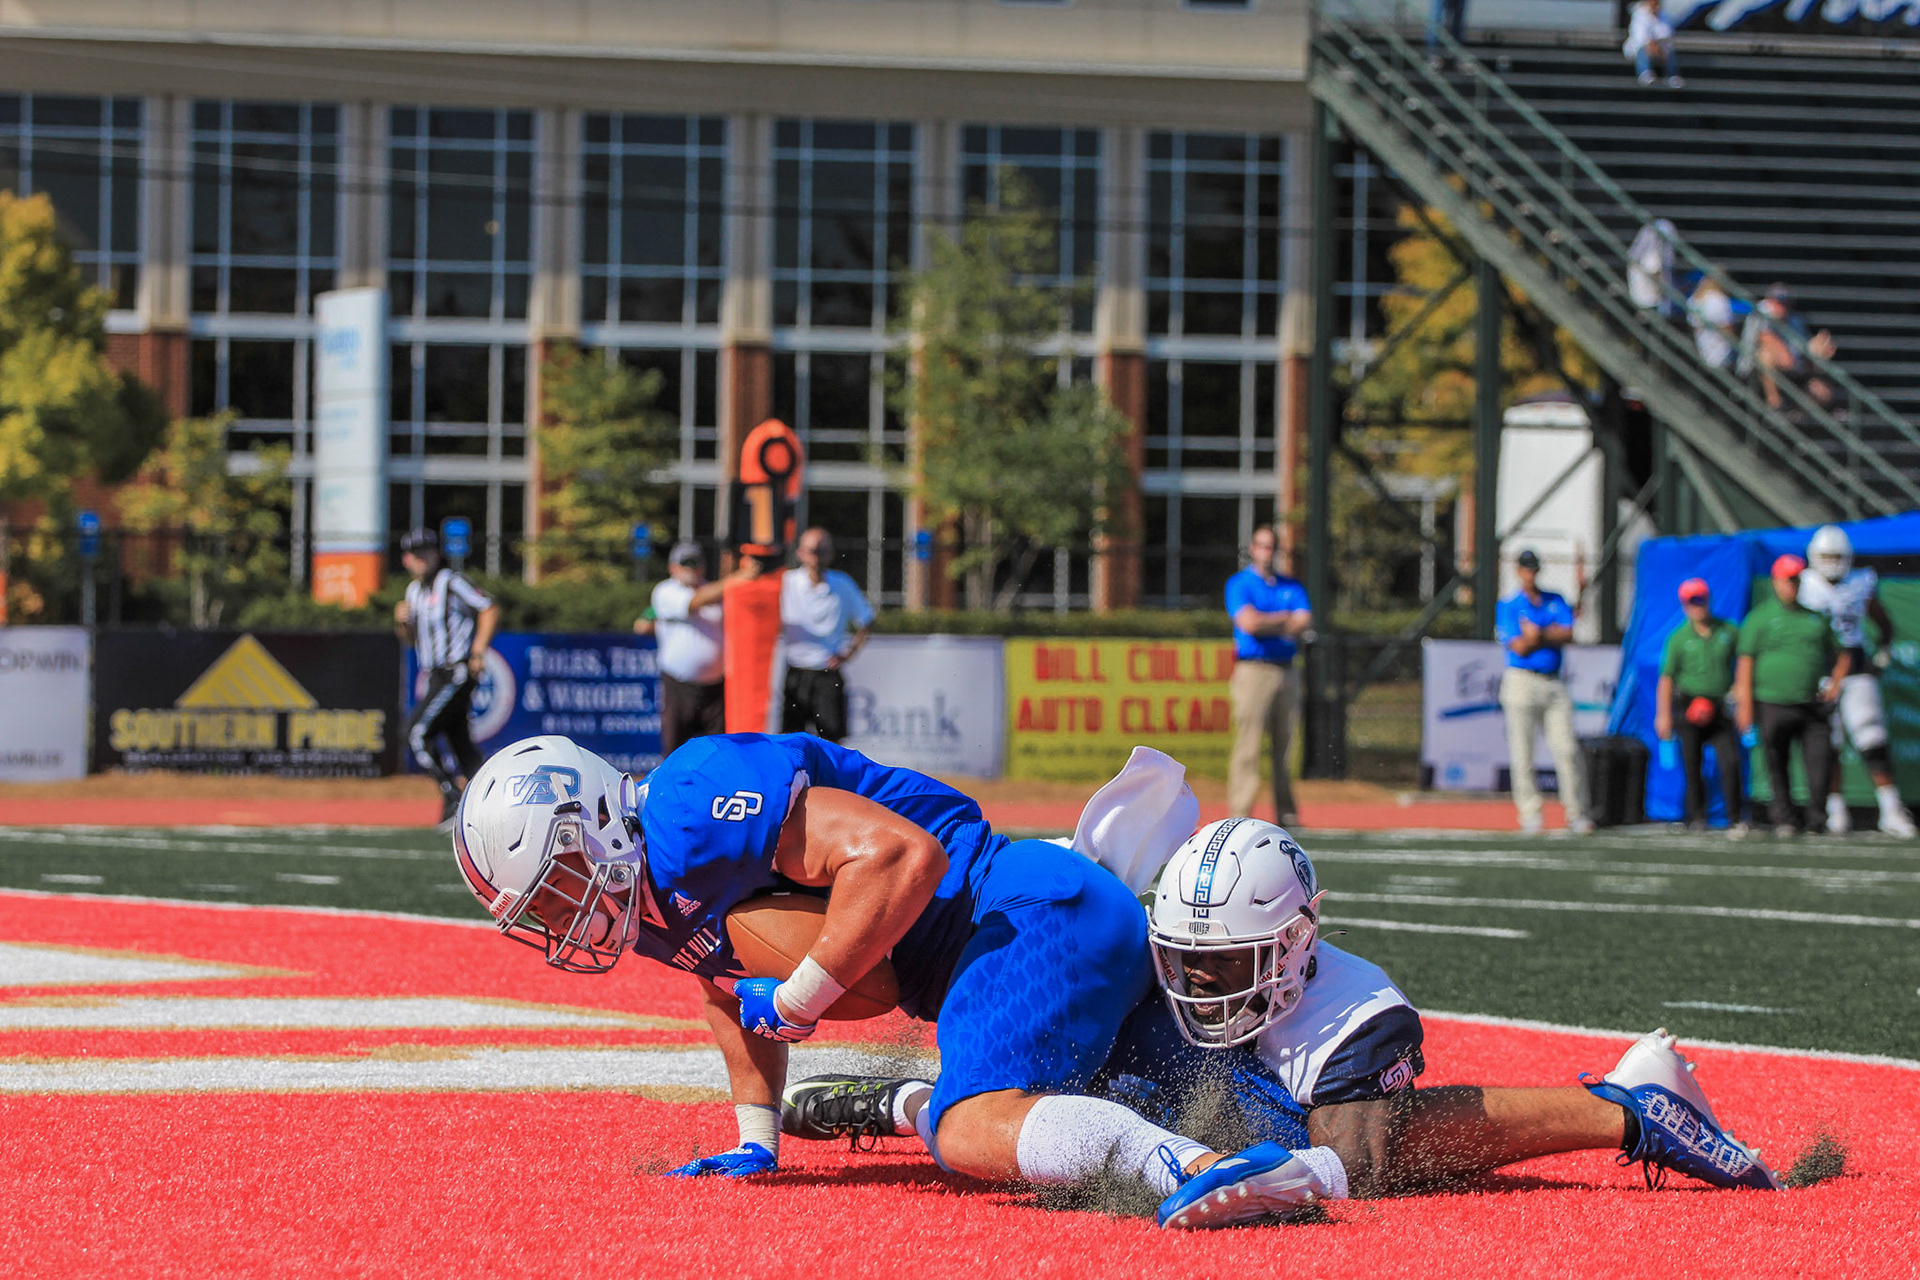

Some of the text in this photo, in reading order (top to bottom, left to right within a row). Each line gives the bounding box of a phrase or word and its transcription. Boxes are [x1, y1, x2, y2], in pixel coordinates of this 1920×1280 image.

[1127, 645, 1235, 683] COLLI
[110, 708, 387, 752] SOUTHERN PRIDE
[848, 687, 961, 736] Bank
[1015, 696, 1102, 733] AUTO
[672, 927, 722, 972] THE HILL
